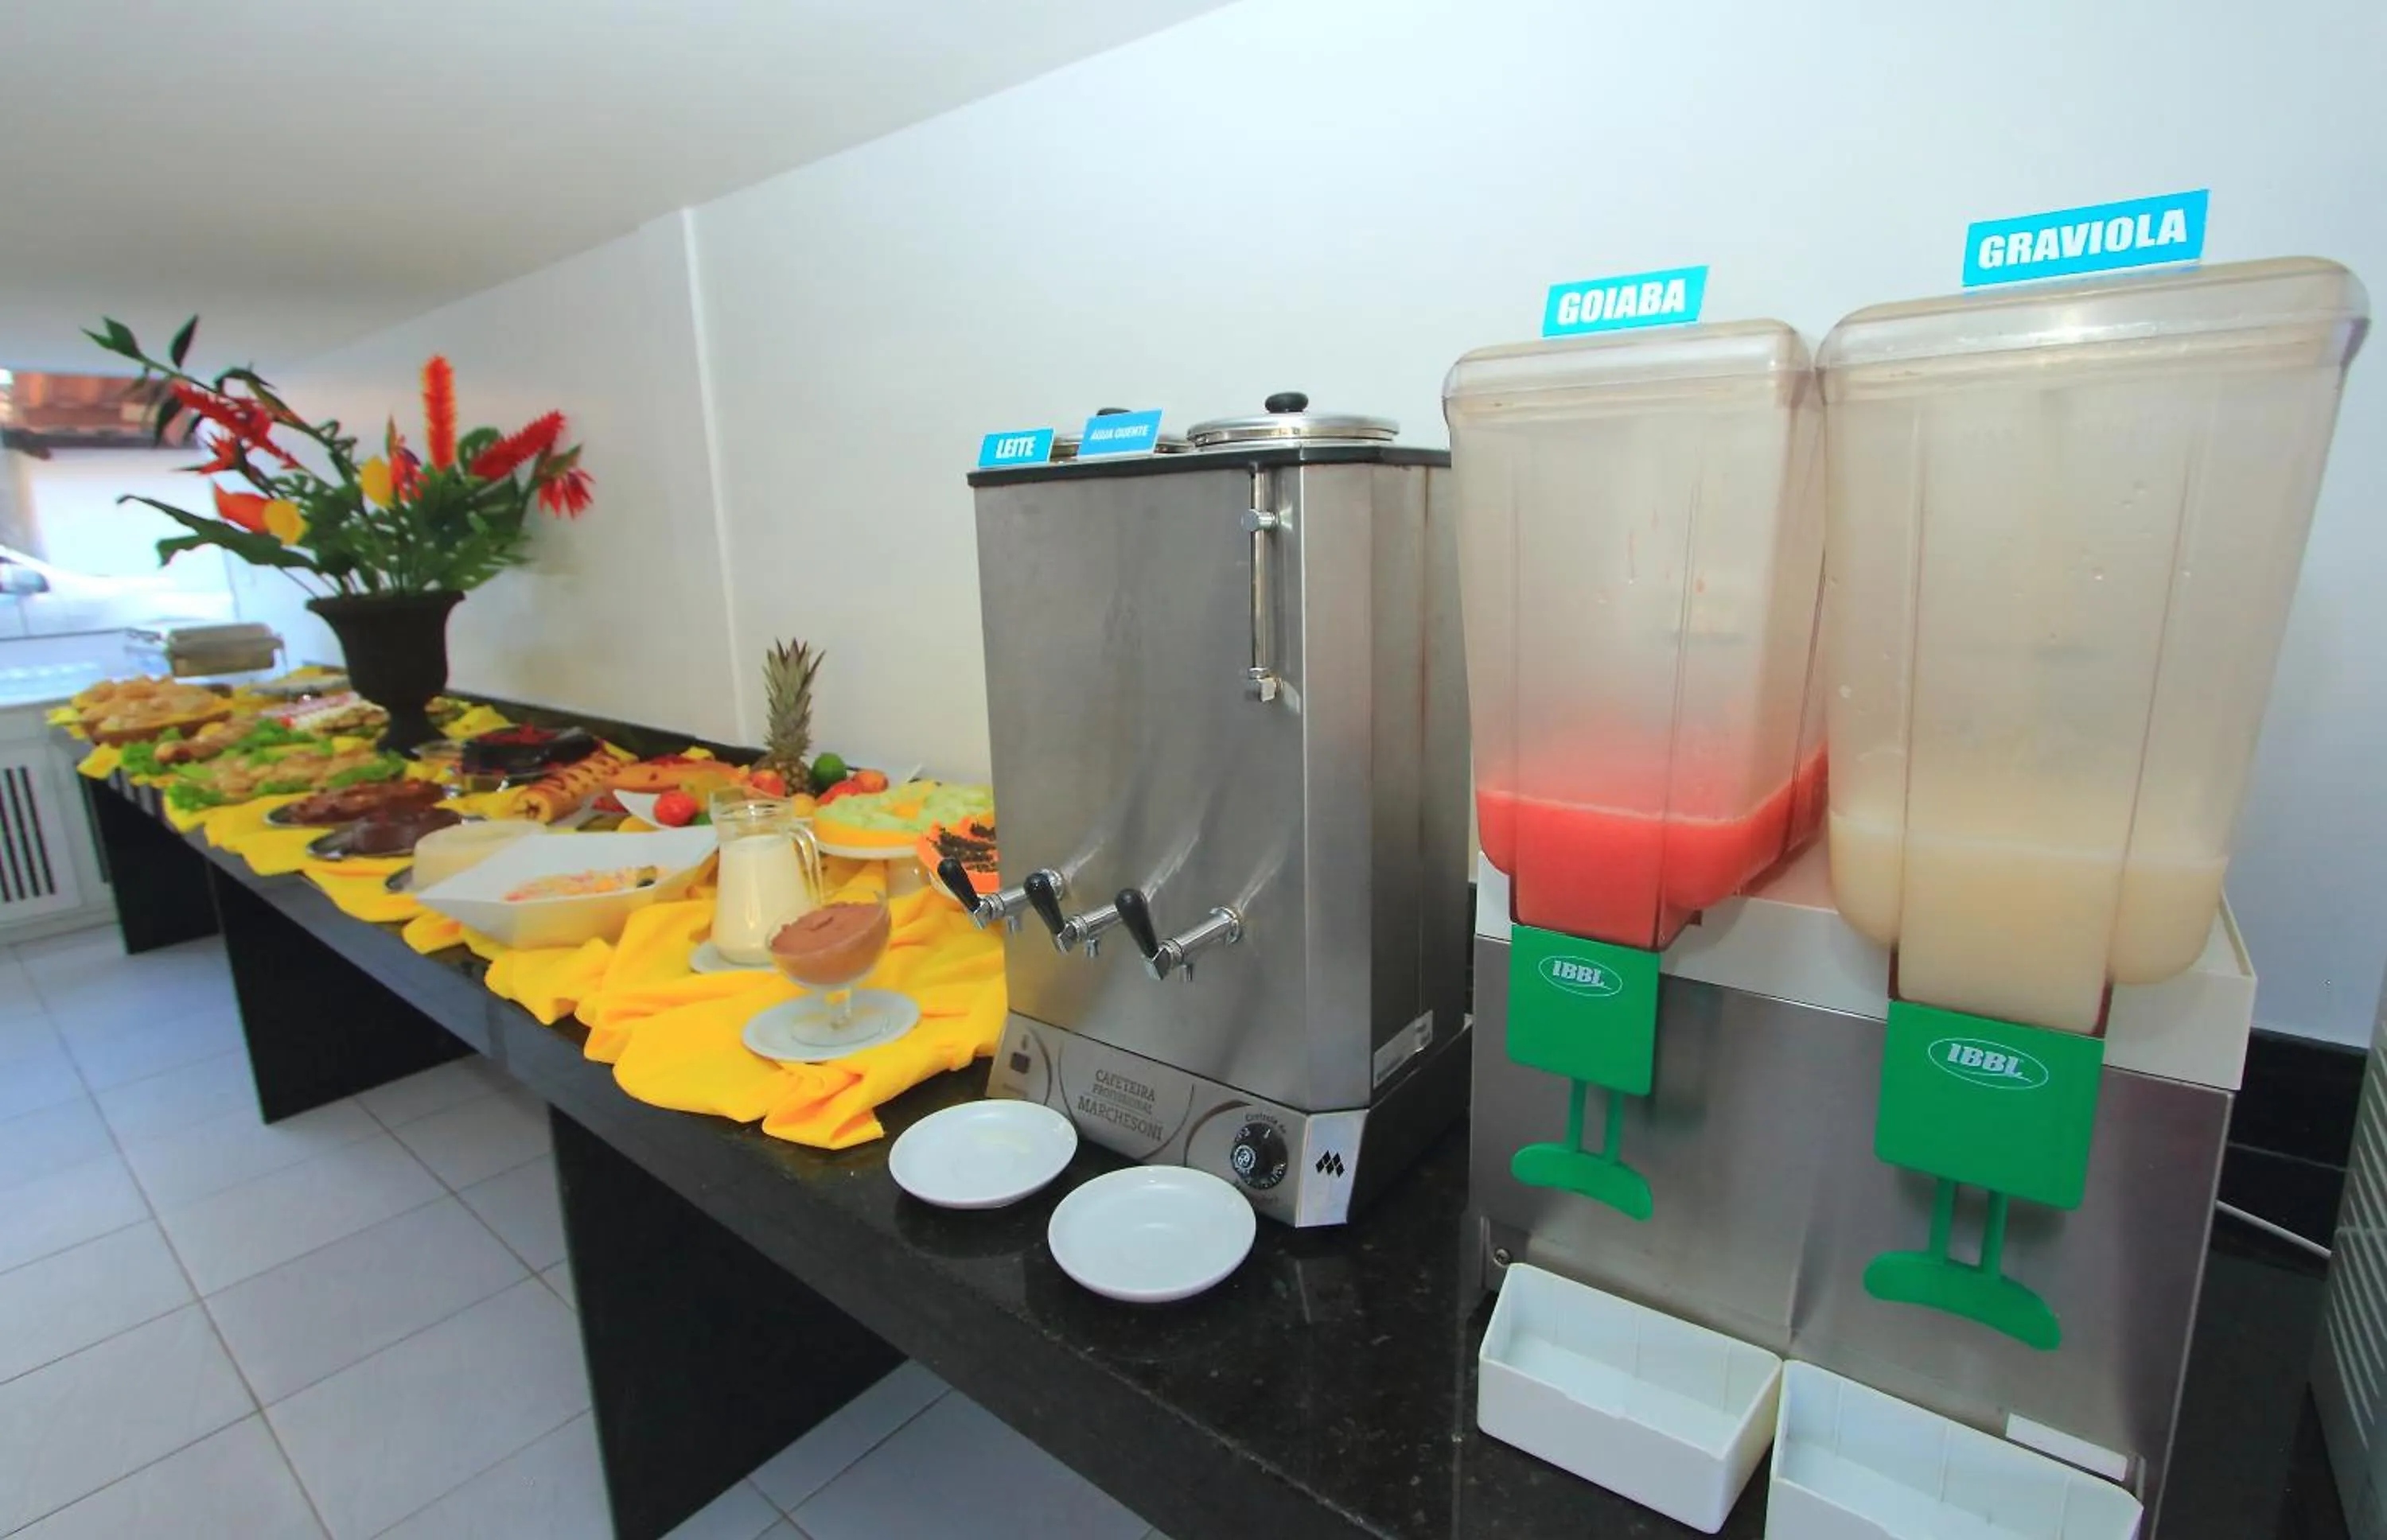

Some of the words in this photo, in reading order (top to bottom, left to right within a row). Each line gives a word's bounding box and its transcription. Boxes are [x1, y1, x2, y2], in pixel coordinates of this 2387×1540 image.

[1978, 208, 2187, 269] GRAVIOLA
[1557, 278, 1685, 325] GOIABA
[995, 436, 1037, 459] LEITE
[1115, 425, 1151, 439] QUENTE
[1552, 960, 1605, 986] IBBL
[1948, 1043, 2023, 1076] IBBL
[1096, 1069, 1155, 1102] CAFETEIRA
[1078, 1095, 1163, 1141] MARCHESONI
